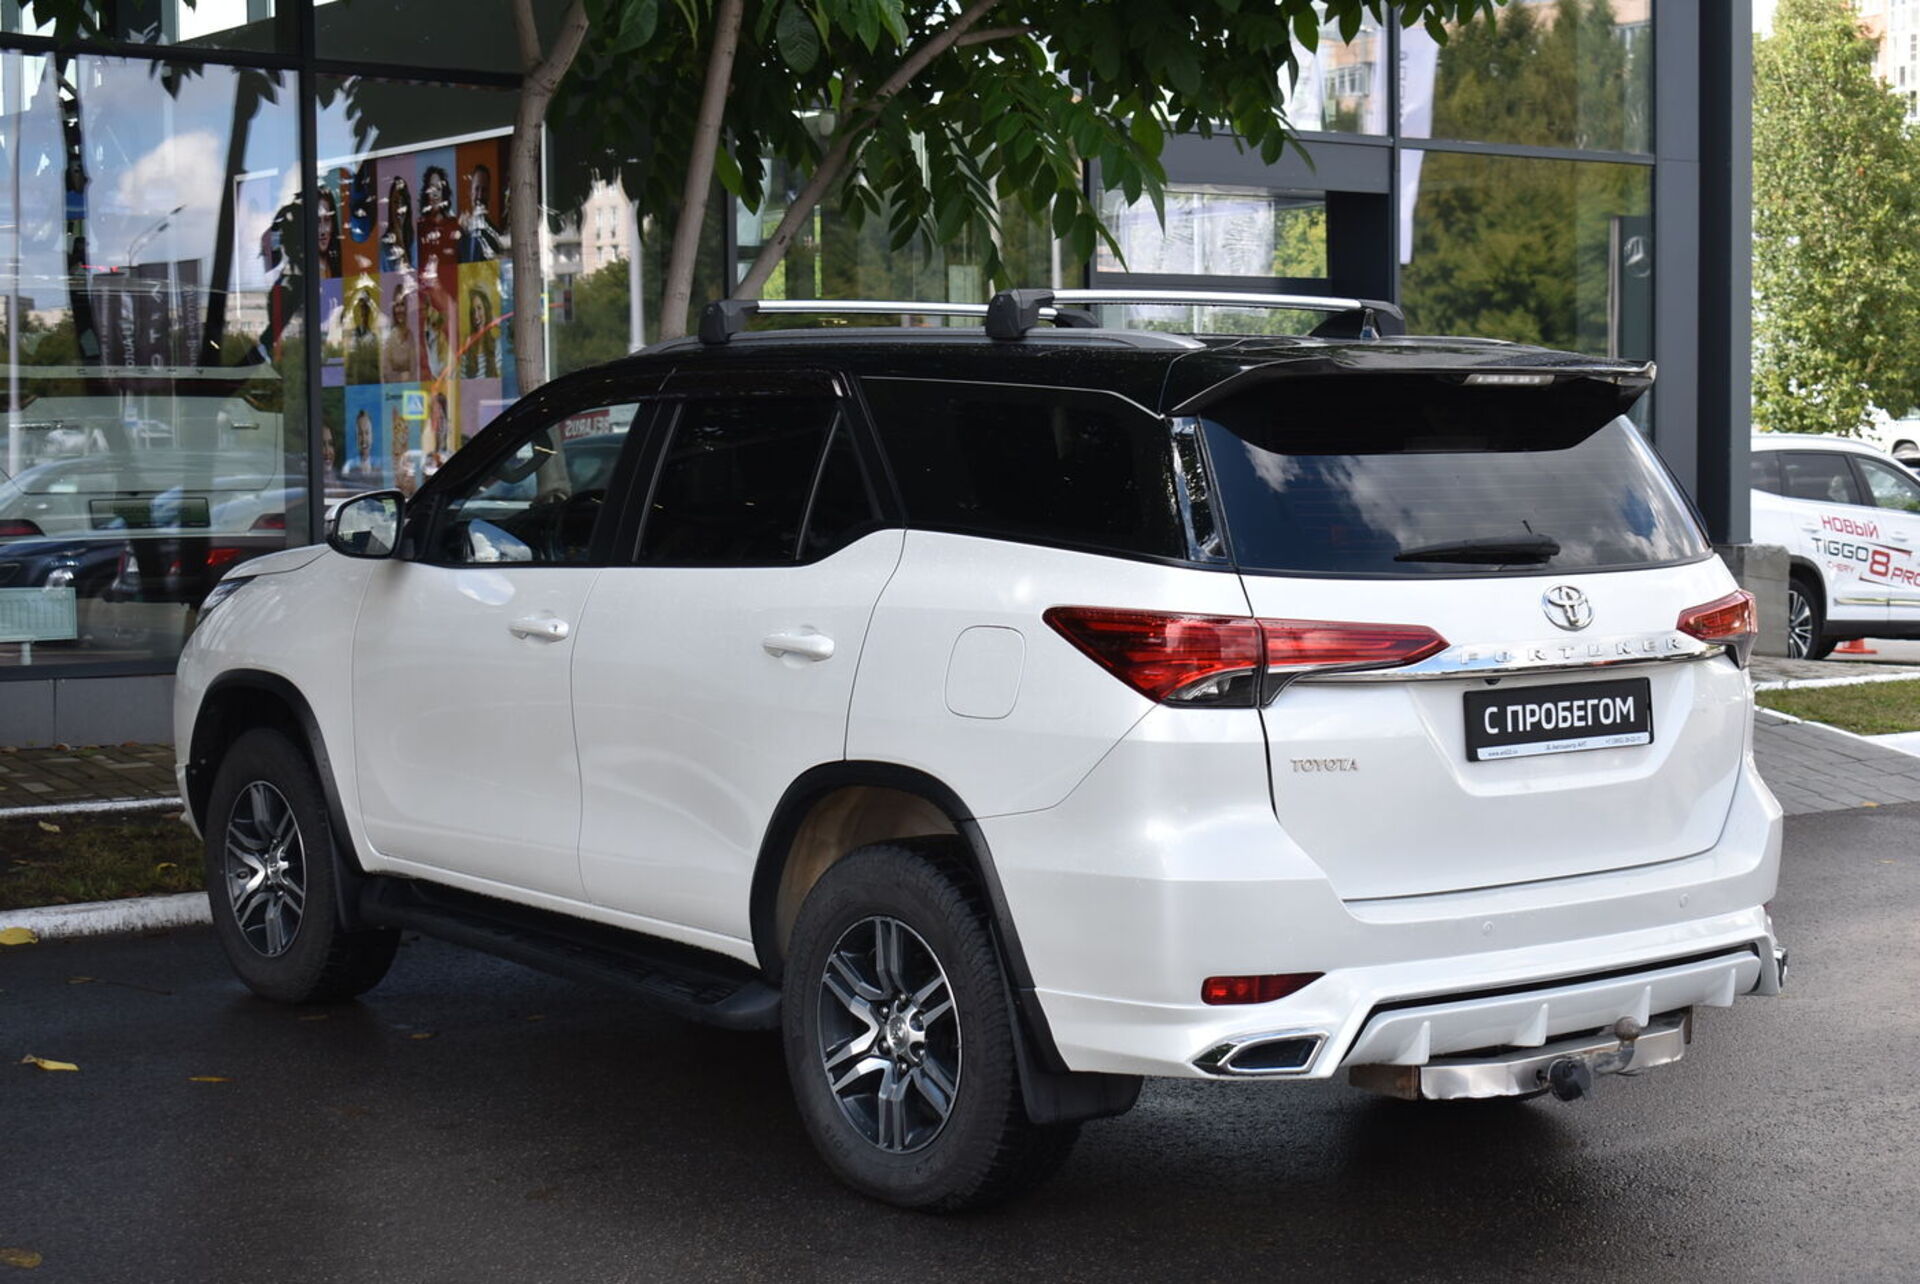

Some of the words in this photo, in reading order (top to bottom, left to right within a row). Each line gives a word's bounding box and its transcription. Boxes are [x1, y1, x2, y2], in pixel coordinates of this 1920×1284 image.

[1821, 515, 1879, 539] НОВЫЙ
[1811, 537, 1868, 562] TIGGO
[1870, 549, 1890, 577] 8
[1459, 636, 1682, 665] FORTUNER
[1484, 706, 1499, 734] С
[1507, 696, 1635, 733] ПРОБЕГОМ
[1290, 758, 1358, 773] TOYOTA
